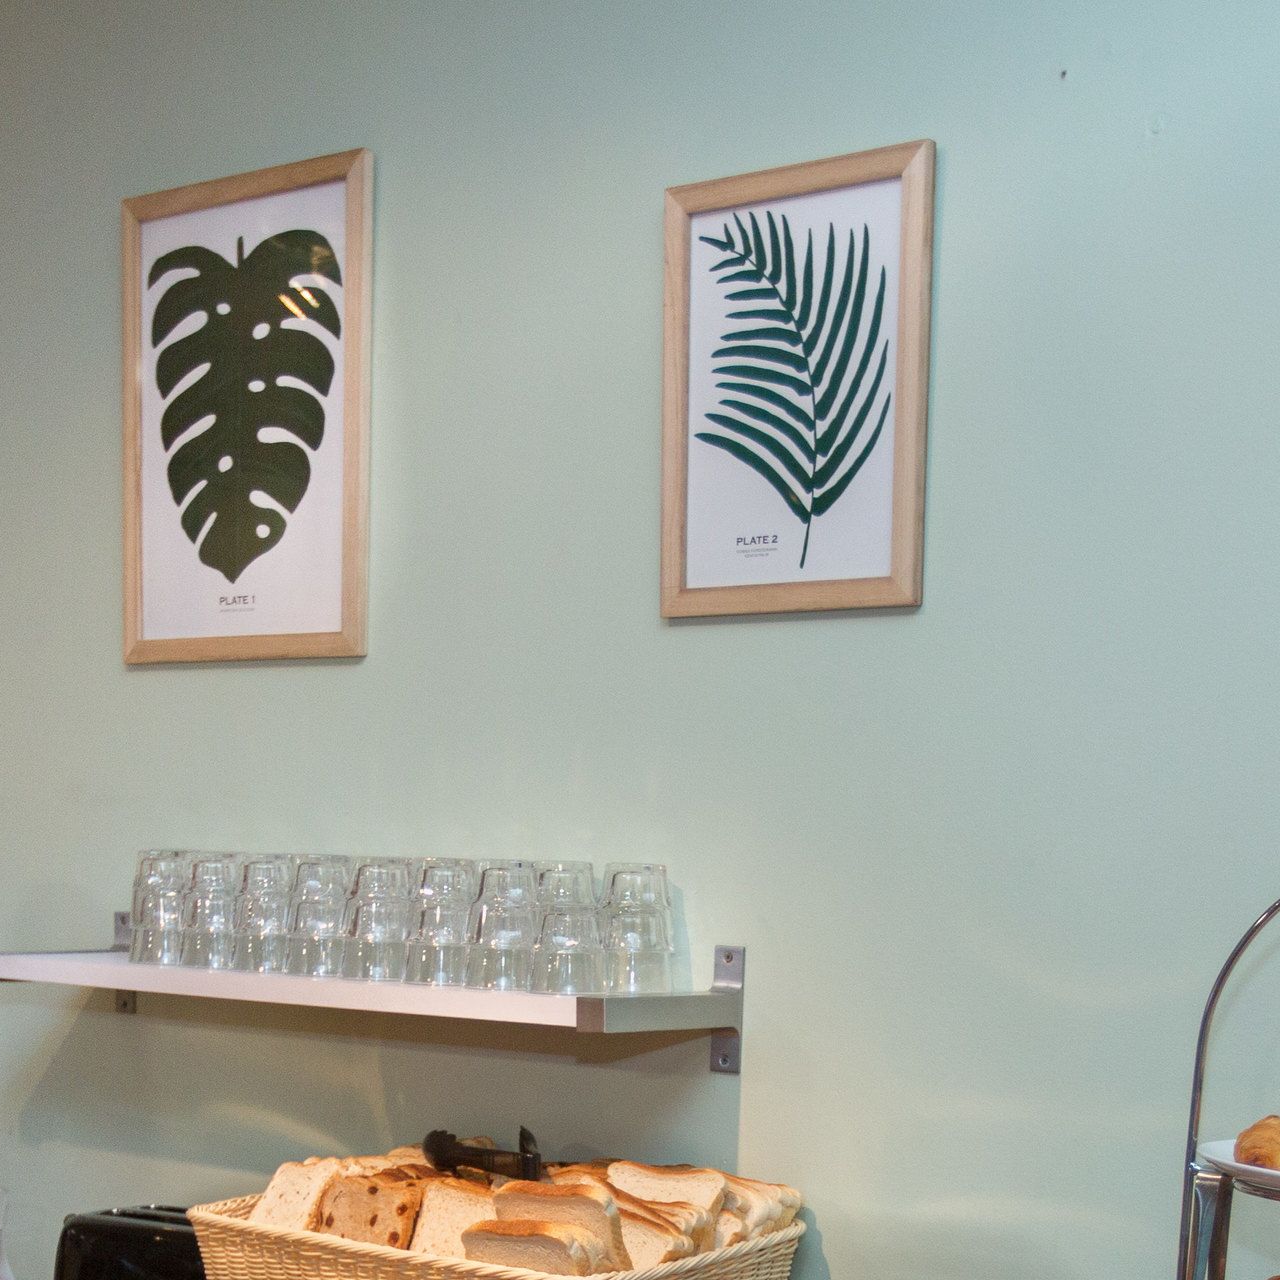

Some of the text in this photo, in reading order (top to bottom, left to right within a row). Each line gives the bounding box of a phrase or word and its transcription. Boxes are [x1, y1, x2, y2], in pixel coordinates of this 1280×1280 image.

[736, 534, 778, 546] PLATE 2
[219, 595, 256, 605] PLATE 1
